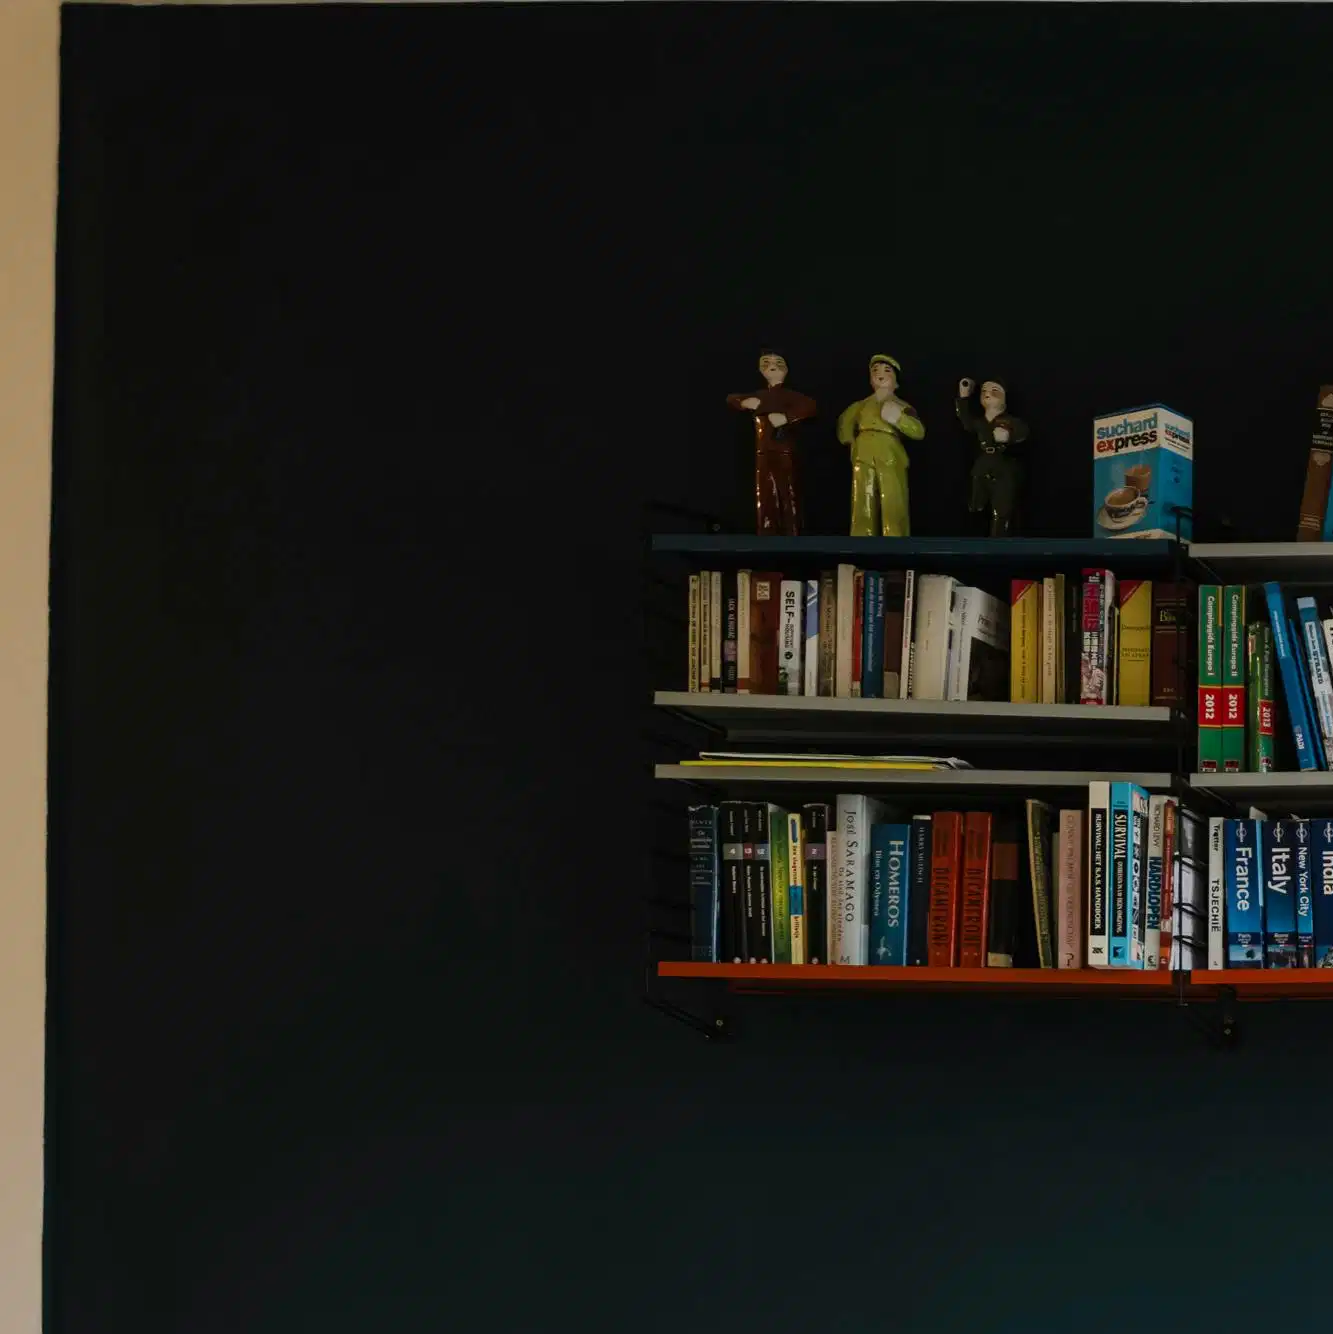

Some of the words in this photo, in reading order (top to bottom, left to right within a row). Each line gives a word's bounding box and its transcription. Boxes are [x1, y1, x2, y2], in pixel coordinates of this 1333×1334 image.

[1097, 412, 1158, 440] suchard
[1097, 430, 1158, 453] express
[1205, 595, 1215, 643] Campinggids
[1229, 594, 1239, 642] Campinggids
[1206, 645, 1215, 670] Europa
[1230, 643, 1239, 668] Europa
[1204, 694, 1215, 719] 2012
[1228, 694, 1239, 719] 2012
[1262, 707, 1272, 728] 2013
[844, 810, 857, 835] José
[1094, 813, 1103, 849] SURVIVAL:
[1153, 804, 1162, 831] RICHARD
[1113, 814, 1128, 860] SURVIVAL
[1152, 832, 1161, 848] LEVY
[1212, 824, 1221, 851] Trotter
[1094, 851, 1103, 866] HET
[1267, 847, 1292, 894] Italy
[1298, 847, 1309, 869] New
[845, 840, 858, 922] SARAMAGO
[873, 869, 882, 880] en
[887, 840, 905, 928] HOMEROS
[1235, 847, 1252, 911] France
[1299, 871, 1309, 893] York
[1147, 856, 1163, 930] HARDLOPEN
[1211, 879, 1221, 933] TSJECHIË
[1297, 895, 1310, 917] City
[1094, 887, 1103, 929] HANDBOEK
